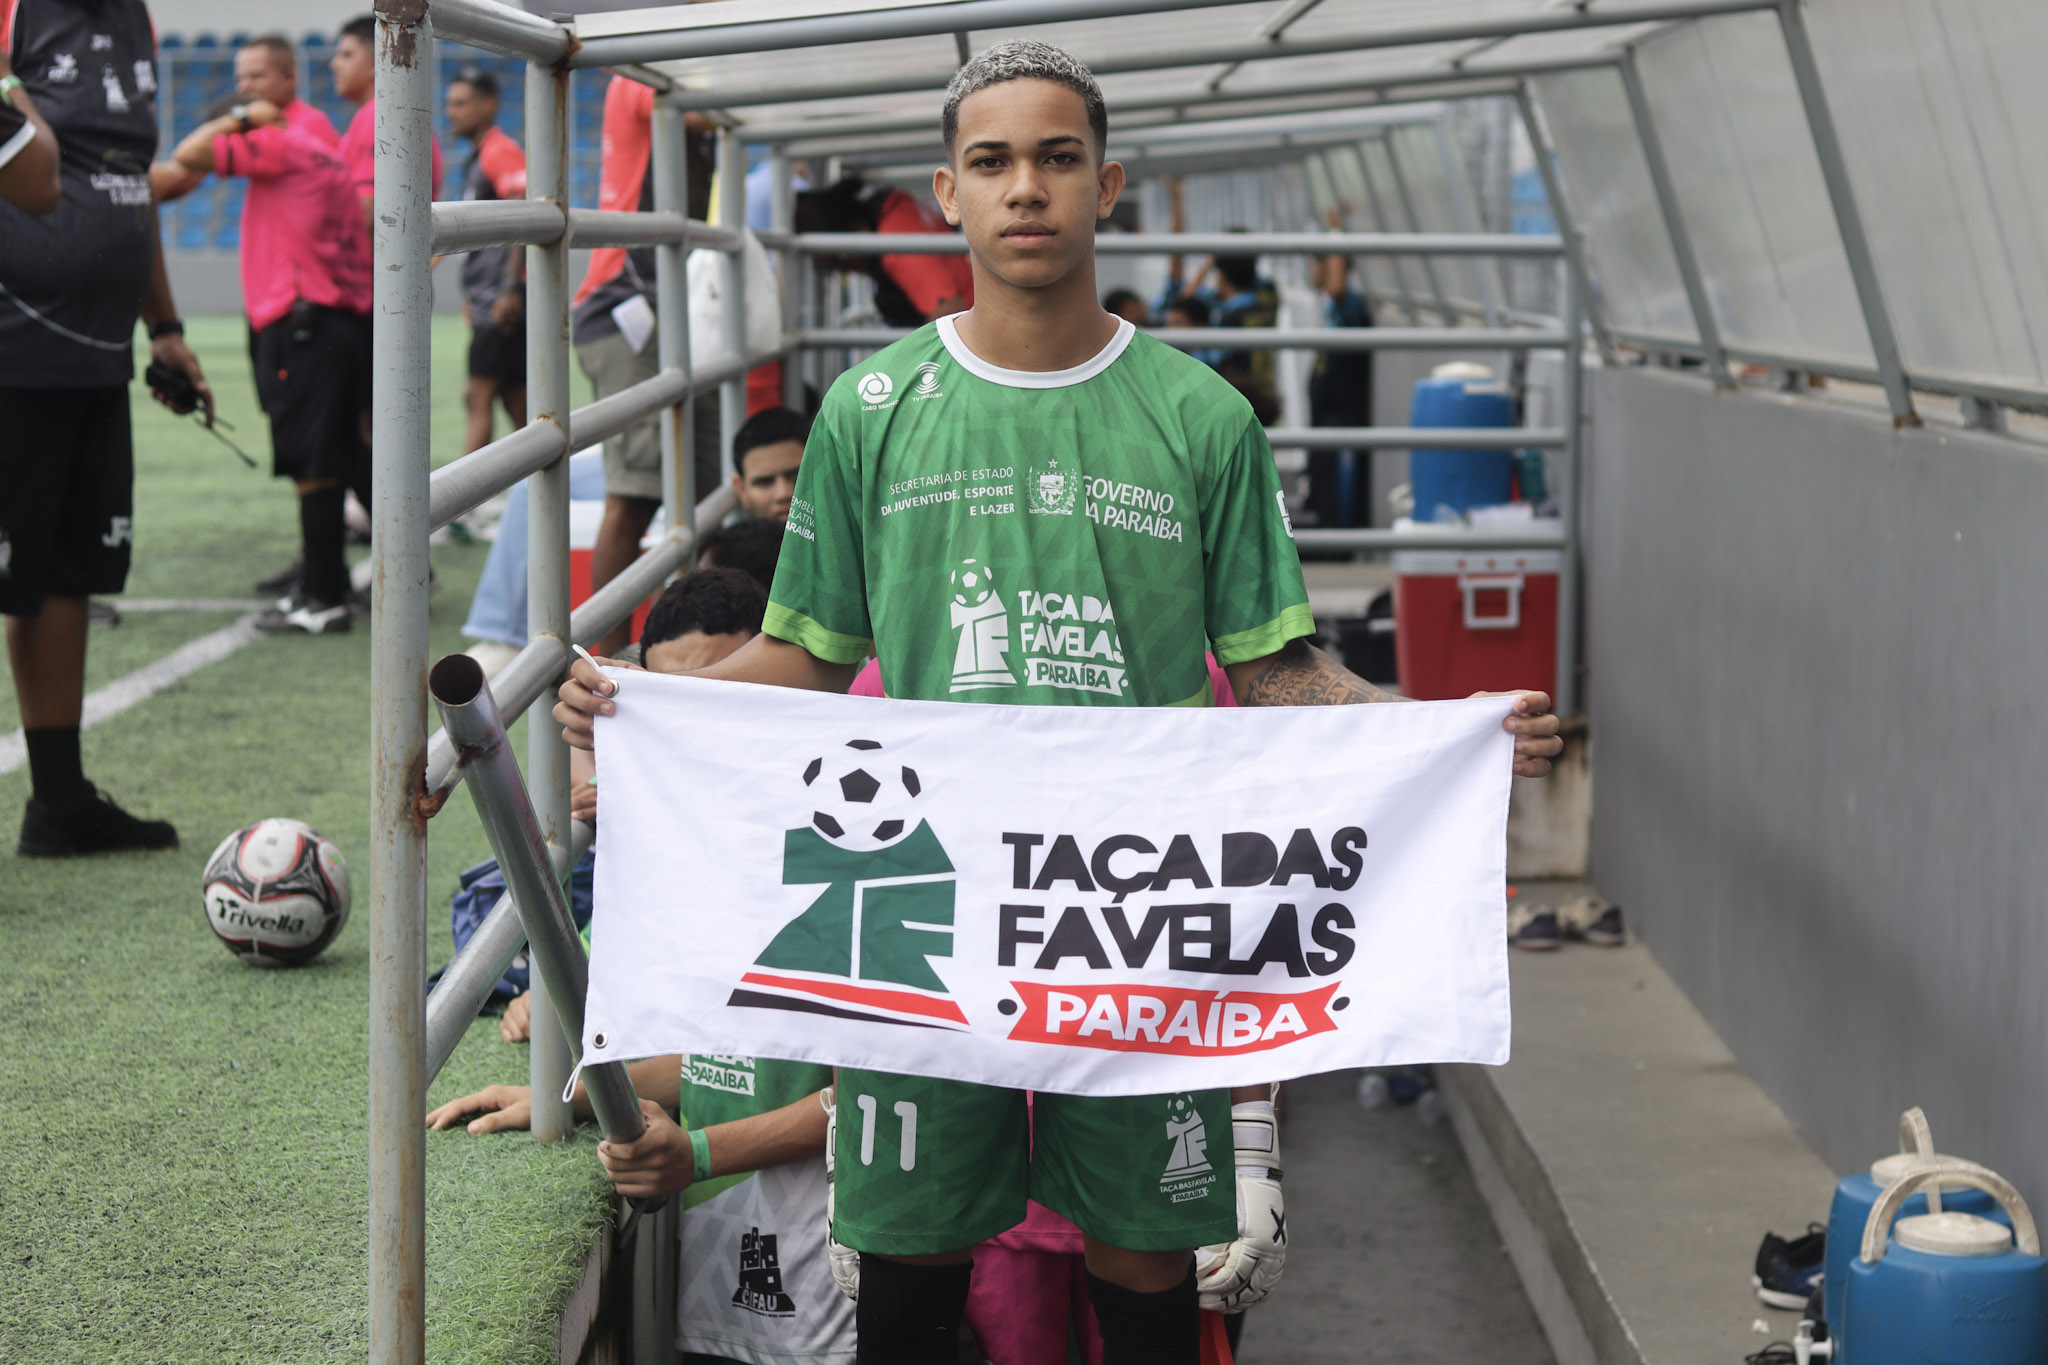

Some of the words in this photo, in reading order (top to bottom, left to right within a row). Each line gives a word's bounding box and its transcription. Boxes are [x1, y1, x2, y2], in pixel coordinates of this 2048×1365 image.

[878, 399, 900, 410] BRANCO
[889, 473, 953, 496] SECRETARIA
[954, 470, 968, 481] DE
[972, 466, 1014, 481] ESTADO
[881, 504, 893, 516] DA
[893, 489, 961, 513] JUVENTUDE,
[964, 484, 1014, 499] ESPORTE
[969, 505, 977, 516] E
[980, 503, 1015, 515] LAZER
[1103, 505, 1183, 543] PARAÍBA
[1018, 590, 1081, 625] TAÇA
[1020, 622, 1126, 664] FAVELAS
[1036, 662, 1112, 690] PARAÍBA
[1002, 831, 1214, 904] TAÇA
[1221, 826, 1368, 892] DAS
[216, 897, 304, 933] Trivella
[998, 902, 1356, 978] FAVELAS
[1045, 990, 1309, 1048] PARAÍBA
[857, 1093, 917, 1172] 11
[1160, 1184, 1178, 1194] TAÇA
[1191, 1174, 1217, 1187] FAVELAS
